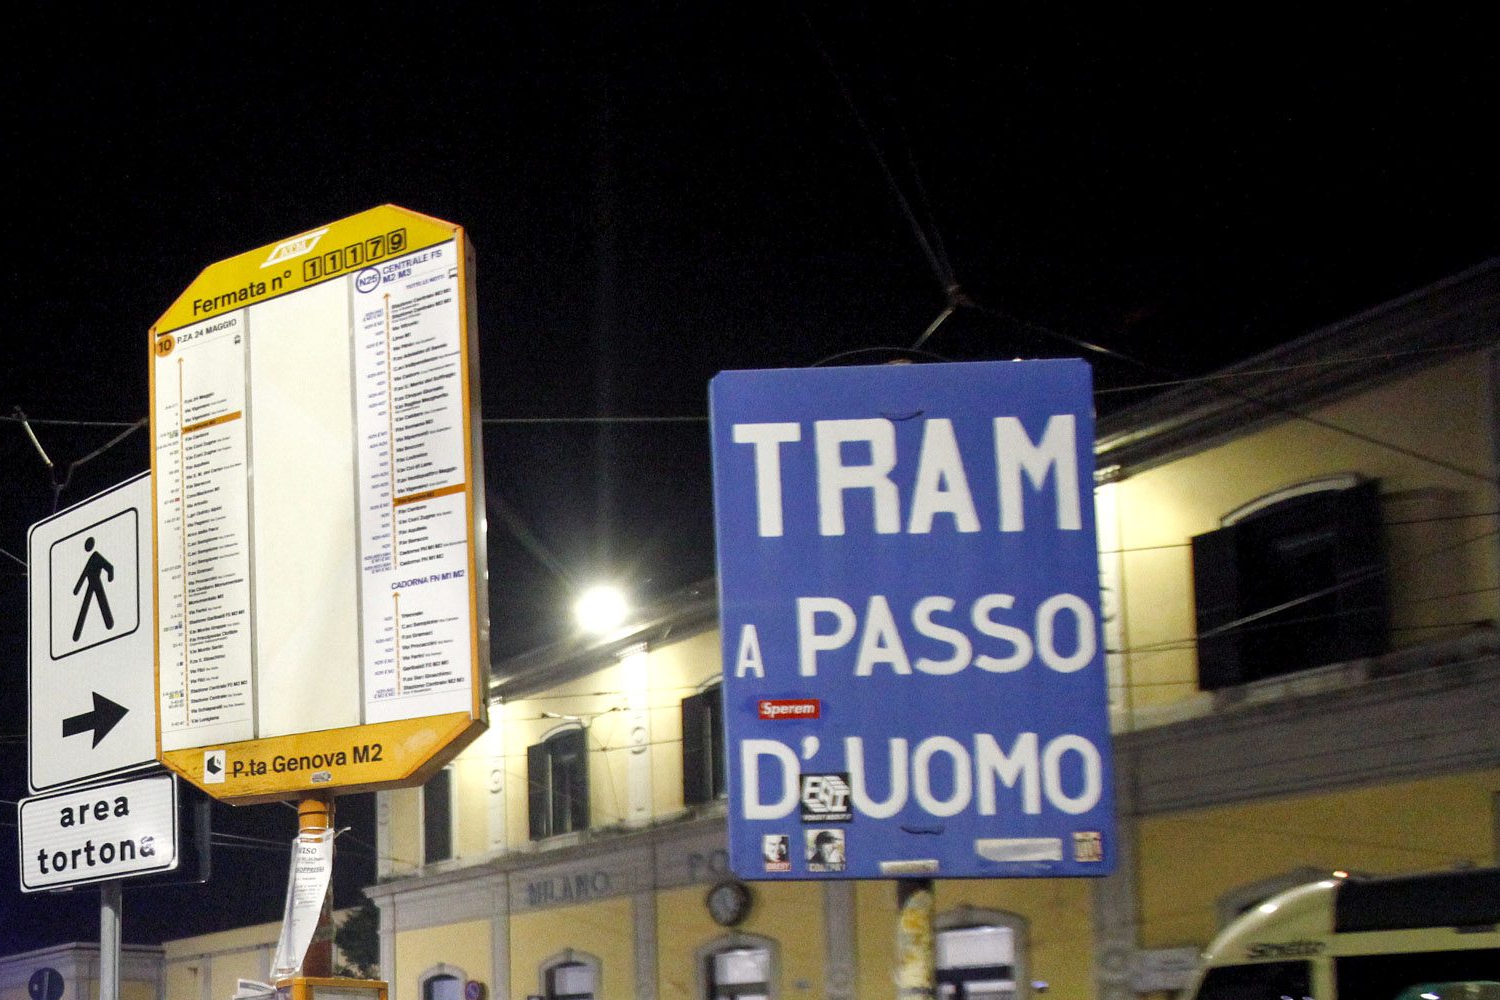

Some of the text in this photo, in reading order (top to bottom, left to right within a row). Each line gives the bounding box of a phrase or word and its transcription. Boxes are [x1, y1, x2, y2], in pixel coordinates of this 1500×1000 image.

[193, 283, 265, 316] Fermata
[308, 234, 403, 277] 11179
[383, 250, 442, 274] CENTRALE FS
[383, 269, 411, 283] M2 M3
[359, 274, 378, 286] N25
[159, 340, 172, 352] 10
[177, 319, 236, 344] P.ZA 24 MAGGIO
[732, 414, 1082, 537] TRAM
[391, 569, 464, 590] CADORNA FN M1 M2
[735, 593, 1097, 678] A PASSO
[762, 702, 815, 718] Sperem
[233, 744, 383, 777] P.ta Genova M2
[740, 732, 1102, 820] D'UOMO
[60, 796, 129, 828] area
[38, 836, 155, 874] tortona
[527, 872, 611, 906] MILANO
